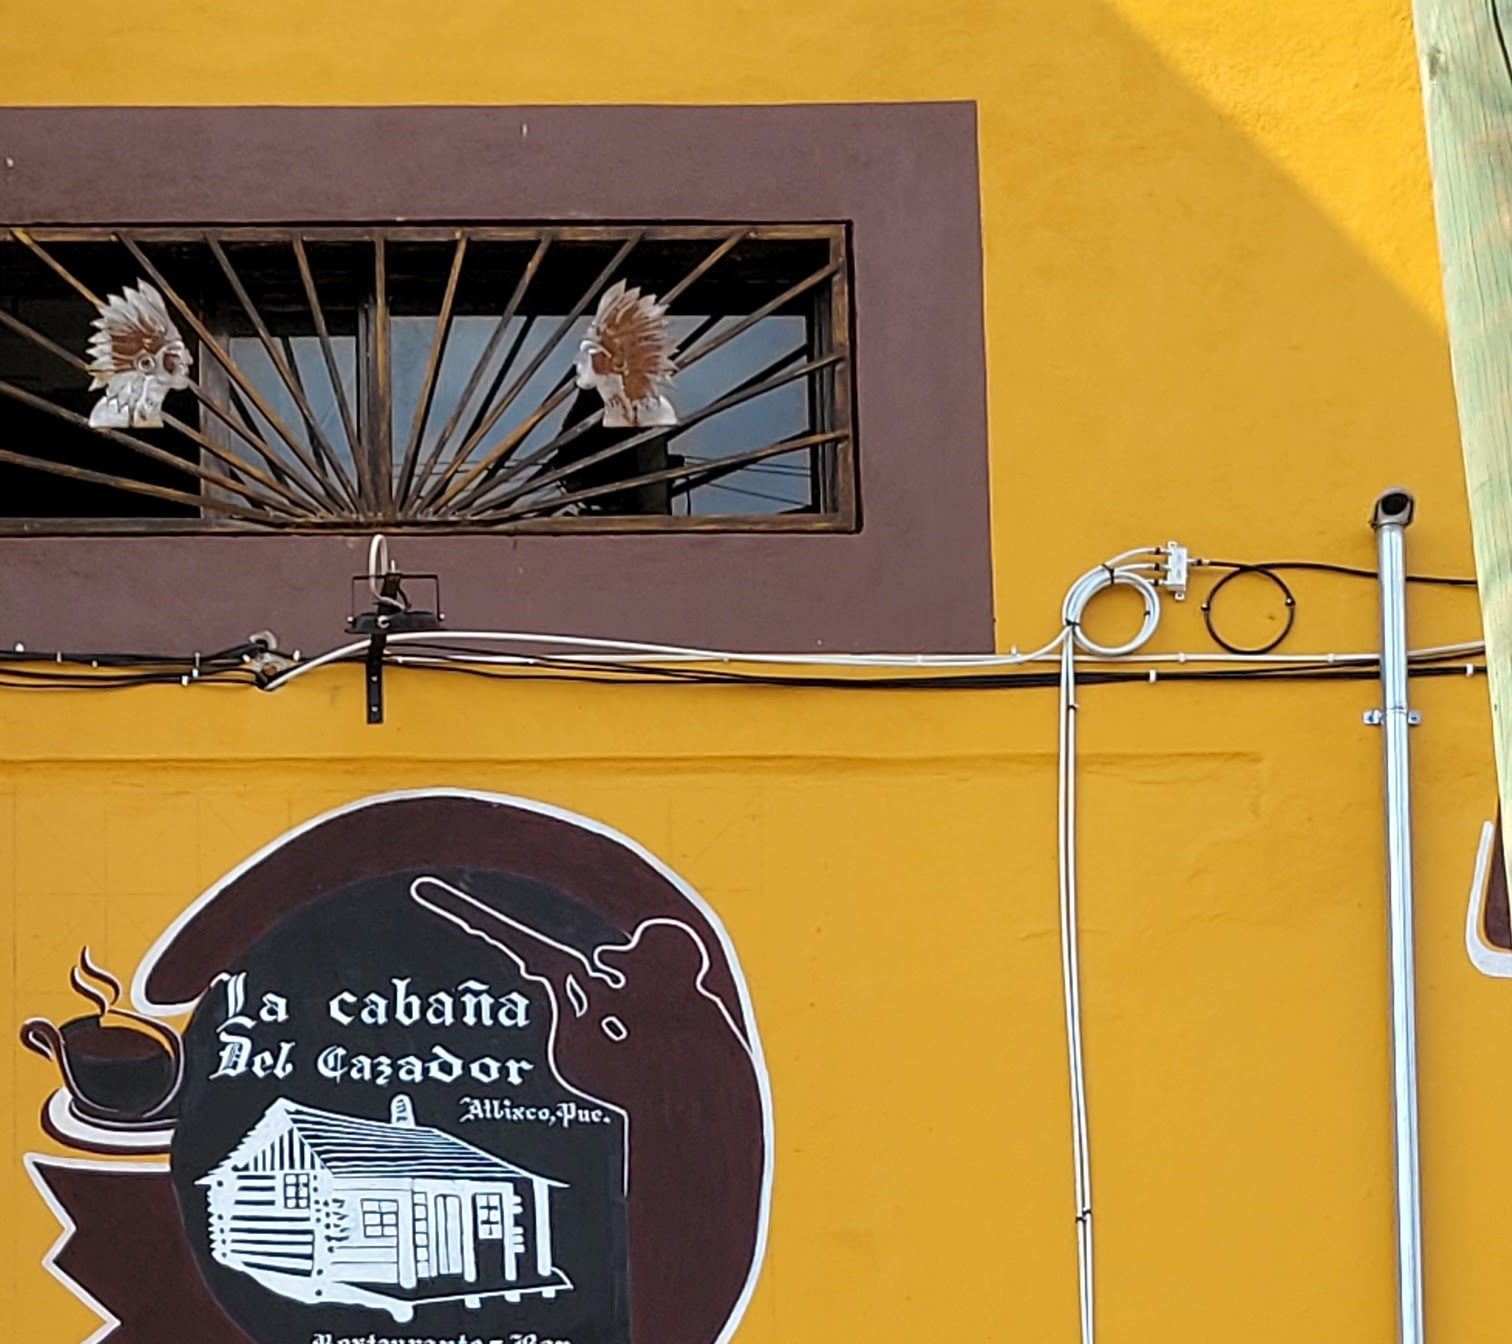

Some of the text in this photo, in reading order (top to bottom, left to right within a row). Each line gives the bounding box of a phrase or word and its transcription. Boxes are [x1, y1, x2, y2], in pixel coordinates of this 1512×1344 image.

[210, 972, 531, 1032] La cabaña
[209, 1031, 534, 1085] Del Cazador
